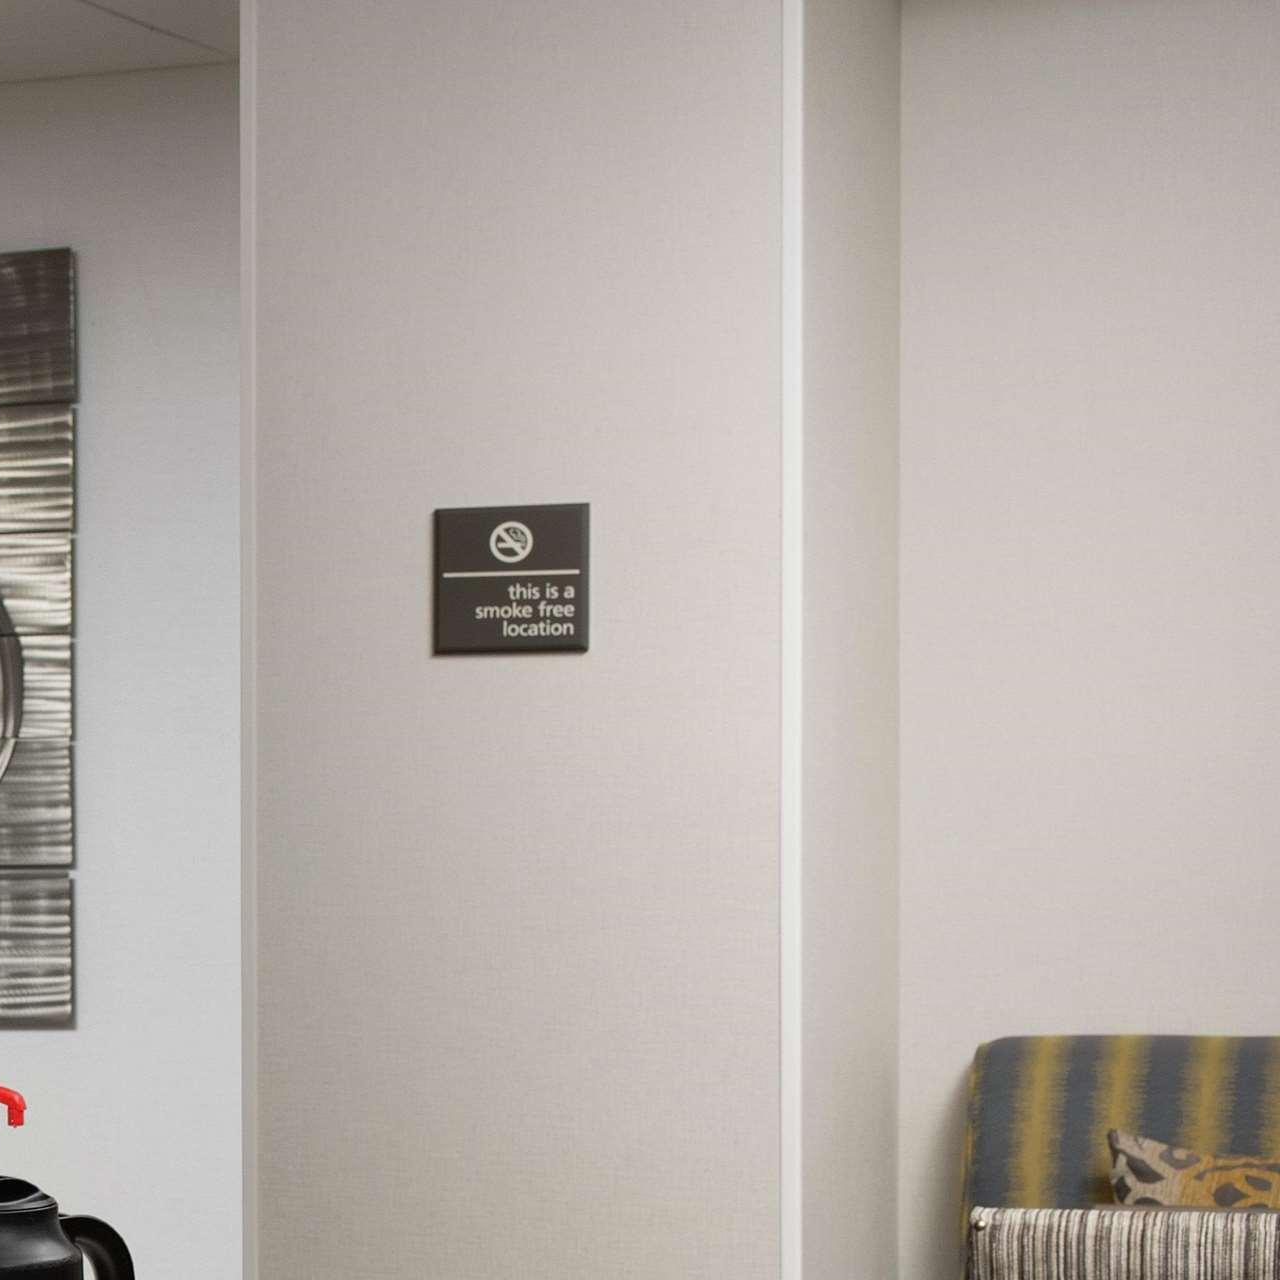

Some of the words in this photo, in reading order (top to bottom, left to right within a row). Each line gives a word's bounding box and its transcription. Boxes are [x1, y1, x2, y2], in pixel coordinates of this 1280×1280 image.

[507, 583, 541, 600] this
[545, 582, 559, 600] is
[563, 585, 576, 599] a
[474, 603, 533, 619] smoke
[538, 602, 576, 617] free
[502, 620, 575, 637] location
